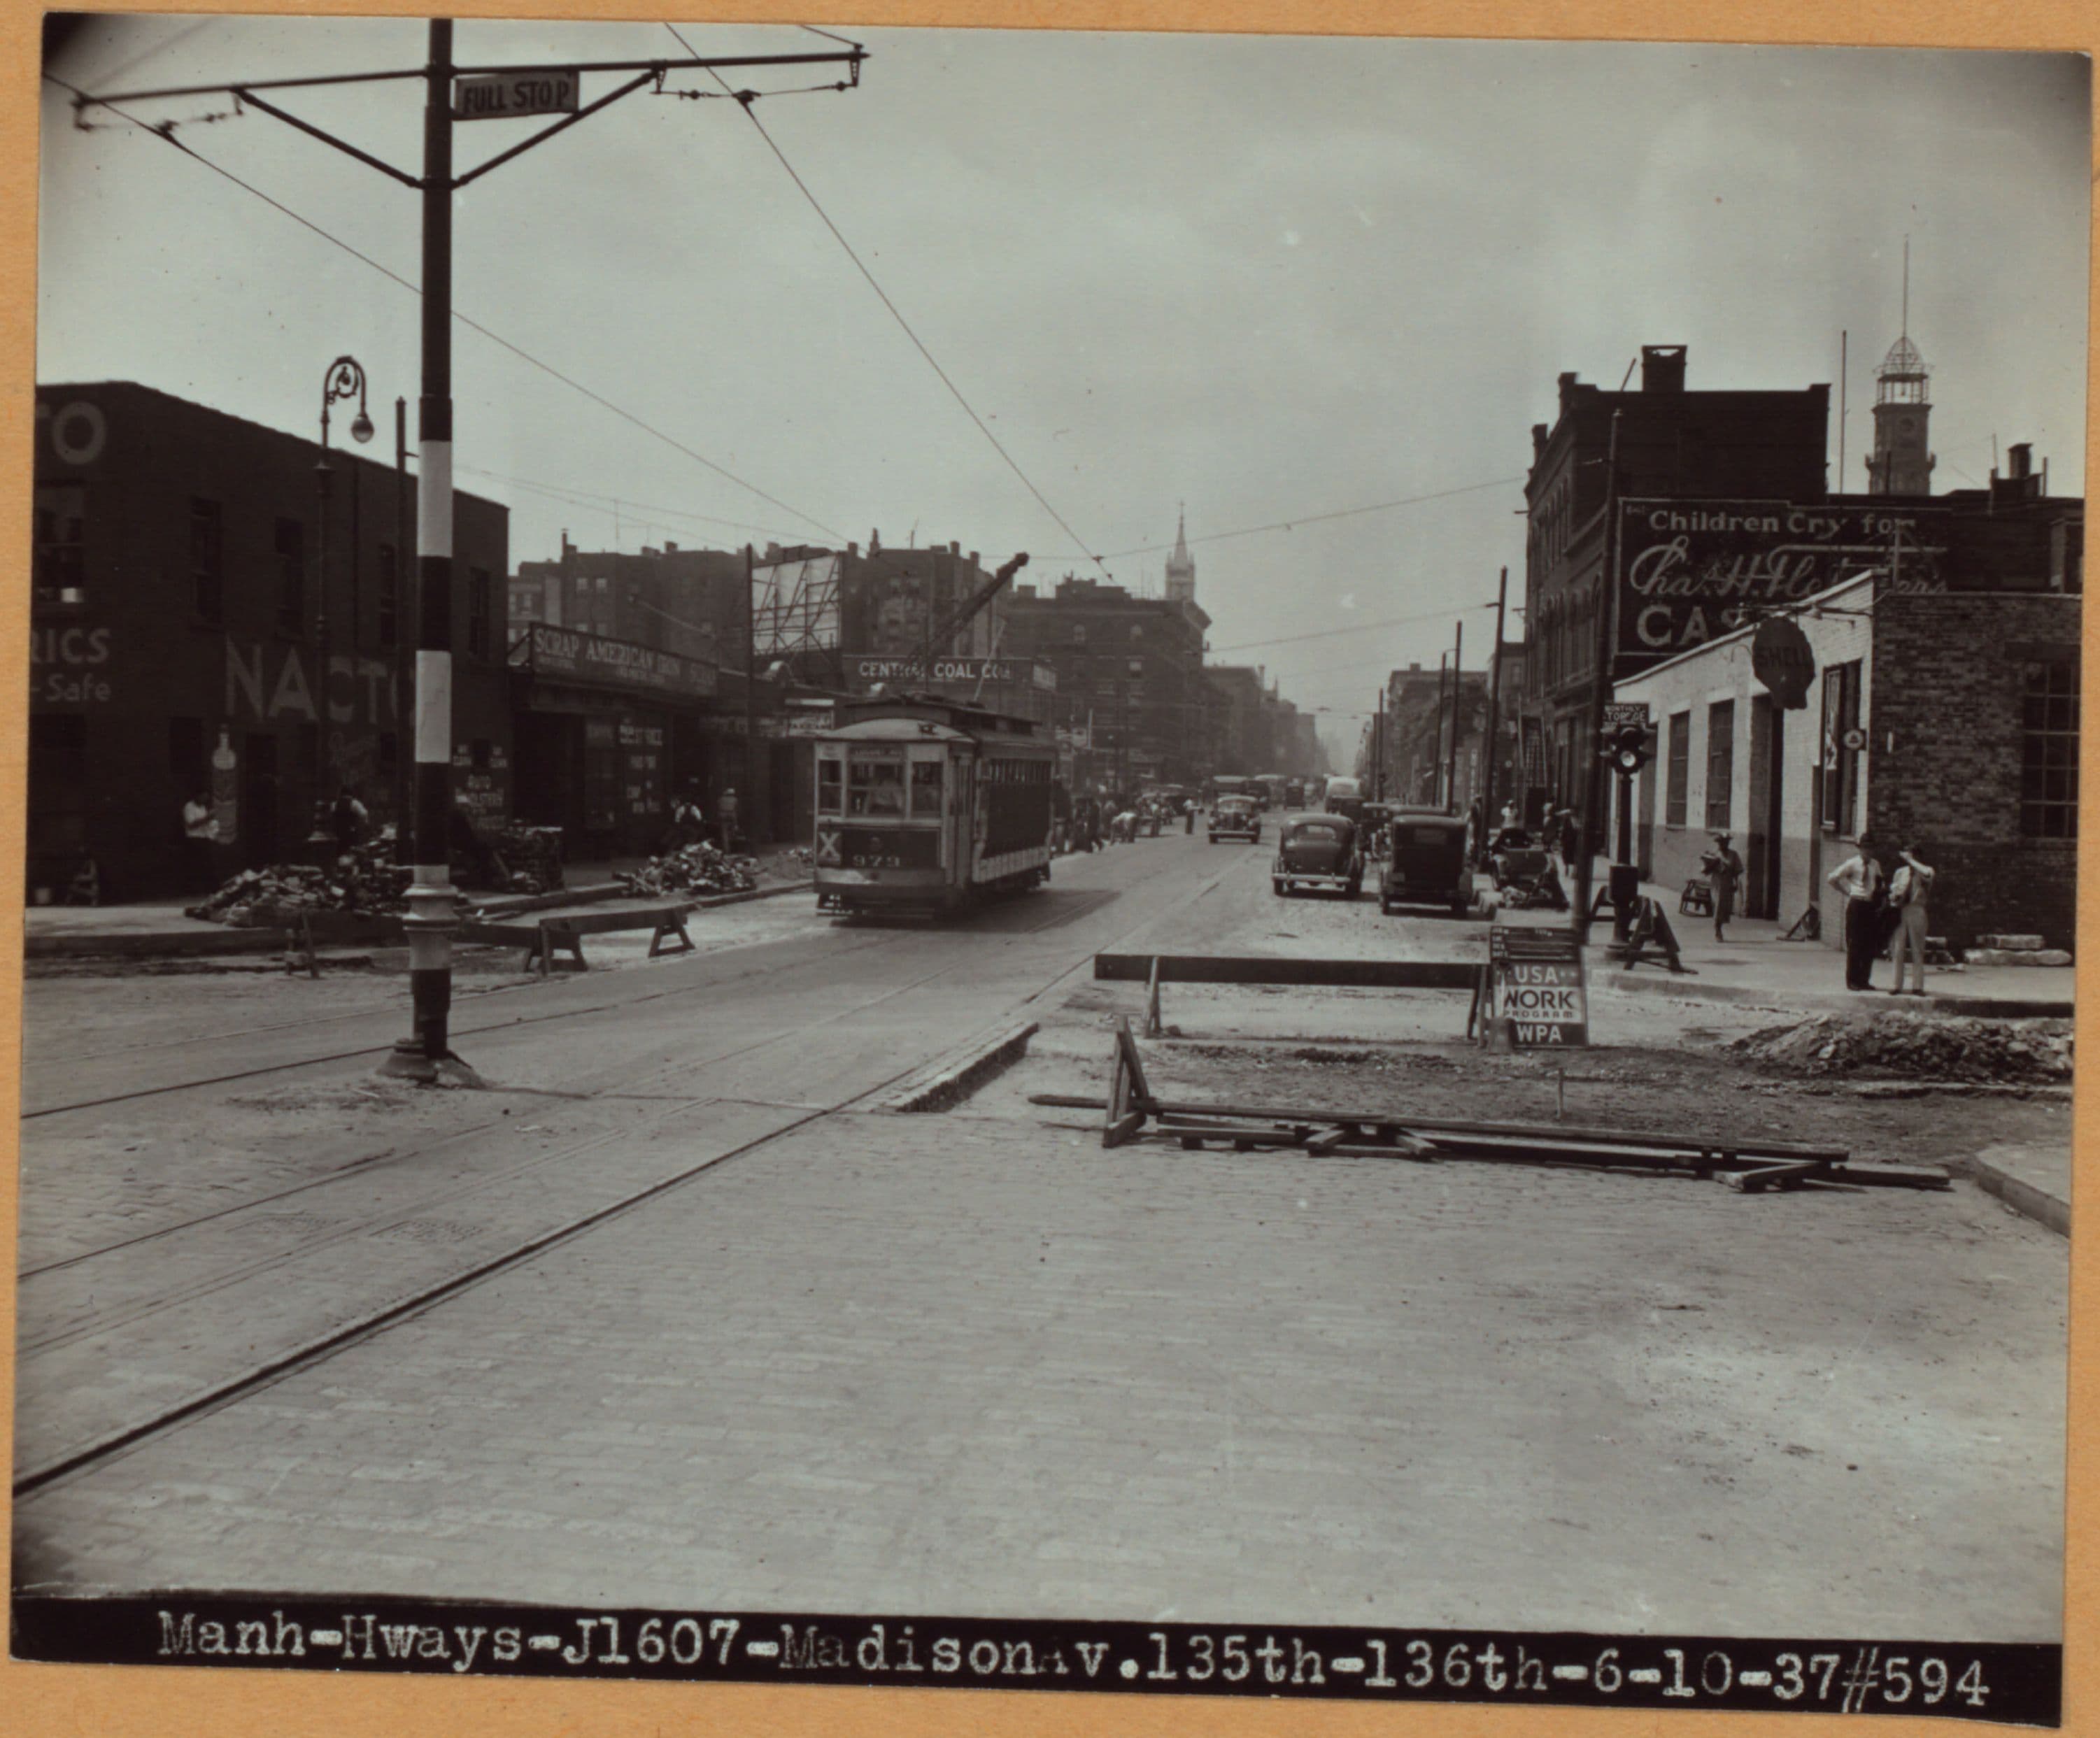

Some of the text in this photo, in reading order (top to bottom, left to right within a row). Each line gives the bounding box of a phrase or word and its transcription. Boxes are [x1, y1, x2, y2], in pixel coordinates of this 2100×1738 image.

[463, 80, 569, 112] FULL STOP
[1649, 511, 1915, 540] Children Cry for
[933, 663, 976, 679] COAL
[46, 673, 112, 702] Safe
[1514, 966, 1558, 983] USA
[1504, 990, 1573, 1009] WORK
[1517, 1025, 1562, 1043] WPA
